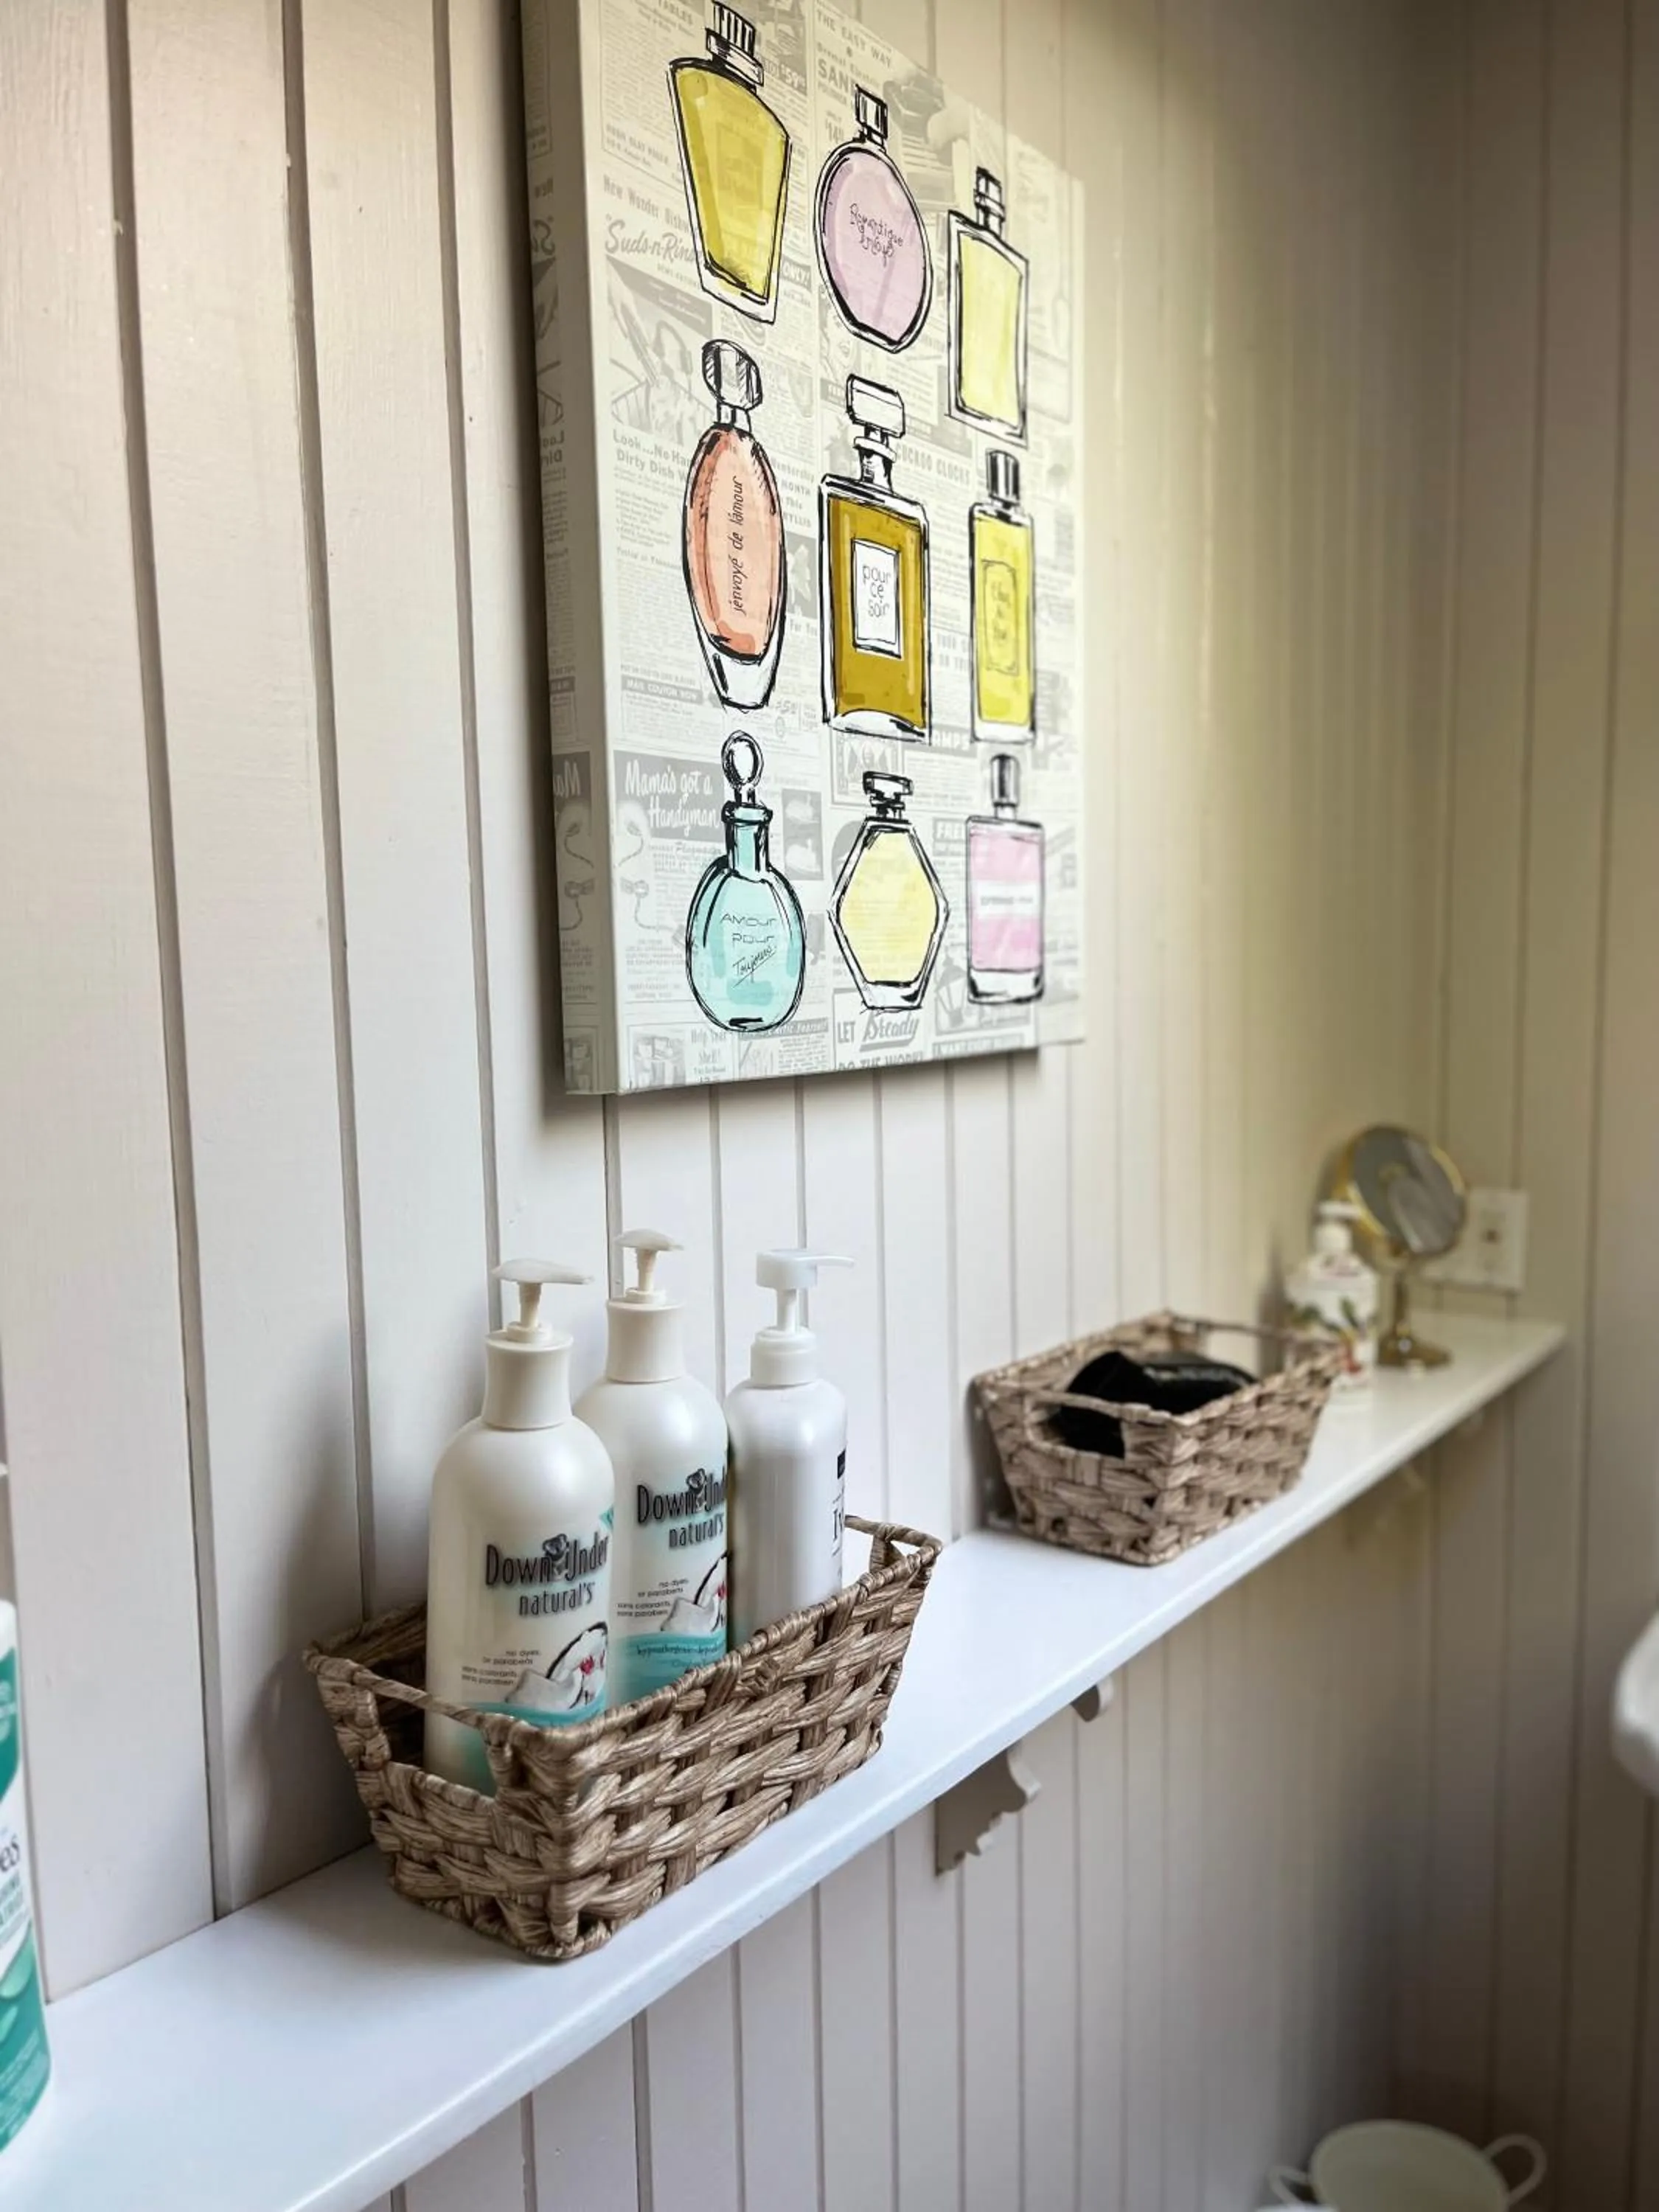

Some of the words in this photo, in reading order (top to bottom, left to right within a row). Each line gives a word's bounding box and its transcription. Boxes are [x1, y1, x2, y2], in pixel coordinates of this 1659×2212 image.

[816, 9, 837, 32] THE
[870, 48, 891, 69] WAY
[616, 448, 646, 471] Dirty
[650, 460, 675, 481] Dish
[863, 565, 891, 585] pour
[679, 770, 700, 803] got
[702, 775, 714, 796] a
[649, 794, 721, 837] Handyman
[837, 1020, 856, 1044] LET
[638, 1484, 695, 1524] Down
[485, 1543, 551, 1586] Down
[564, 1531, 609, 1582] Under
[518, 1582, 593, 1616] natural's
